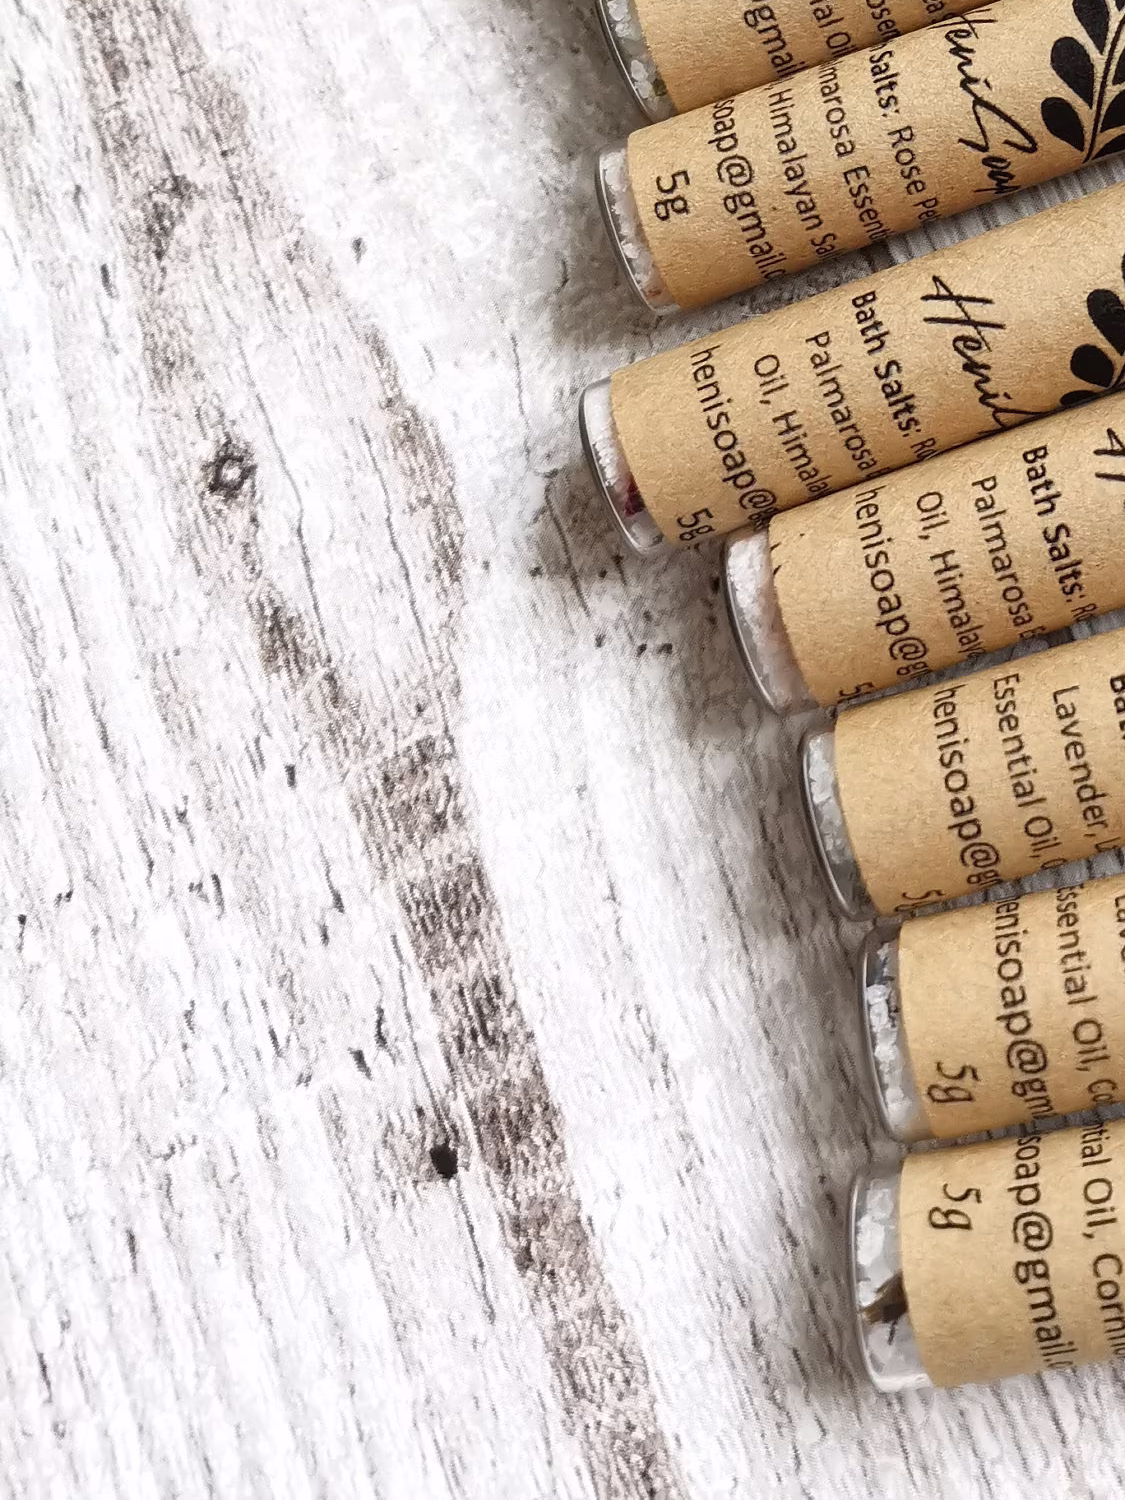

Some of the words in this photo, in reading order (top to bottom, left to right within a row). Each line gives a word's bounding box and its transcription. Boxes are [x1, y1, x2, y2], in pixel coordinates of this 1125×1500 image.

[768, 86, 824, 232] Himalayan
[870, 50, 902, 118] Salts:
[888, 125, 928, 196] Rose
[654, 170, 691, 222] 5g
[754, 353, 789, 406] Oil,
[805, 331, 877, 473] Palmarosa
[852, 290, 890, 356] Bath
[874, 359, 922, 439] Salts:
[676, 507, 714, 543] 5g
[917, 490, 949, 541] Oil,
[971, 475, 1033, 628] Palmarosa
[1023, 445, 1063, 517] Bath
[1043, 523, 1087, 604] Salts:
[993, 672, 1048, 808] Essential
[1024, 814, 1063, 860] Oil,
[1052, 684, 1112, 838] Lavender,
[926, 1060, 983, 1106] 5g
[1071, 1017, 1112, 1072] Oil,
[928, 1181, 983, 1233] 5g
[1082, 1181, 1119, 1241] Oil,
